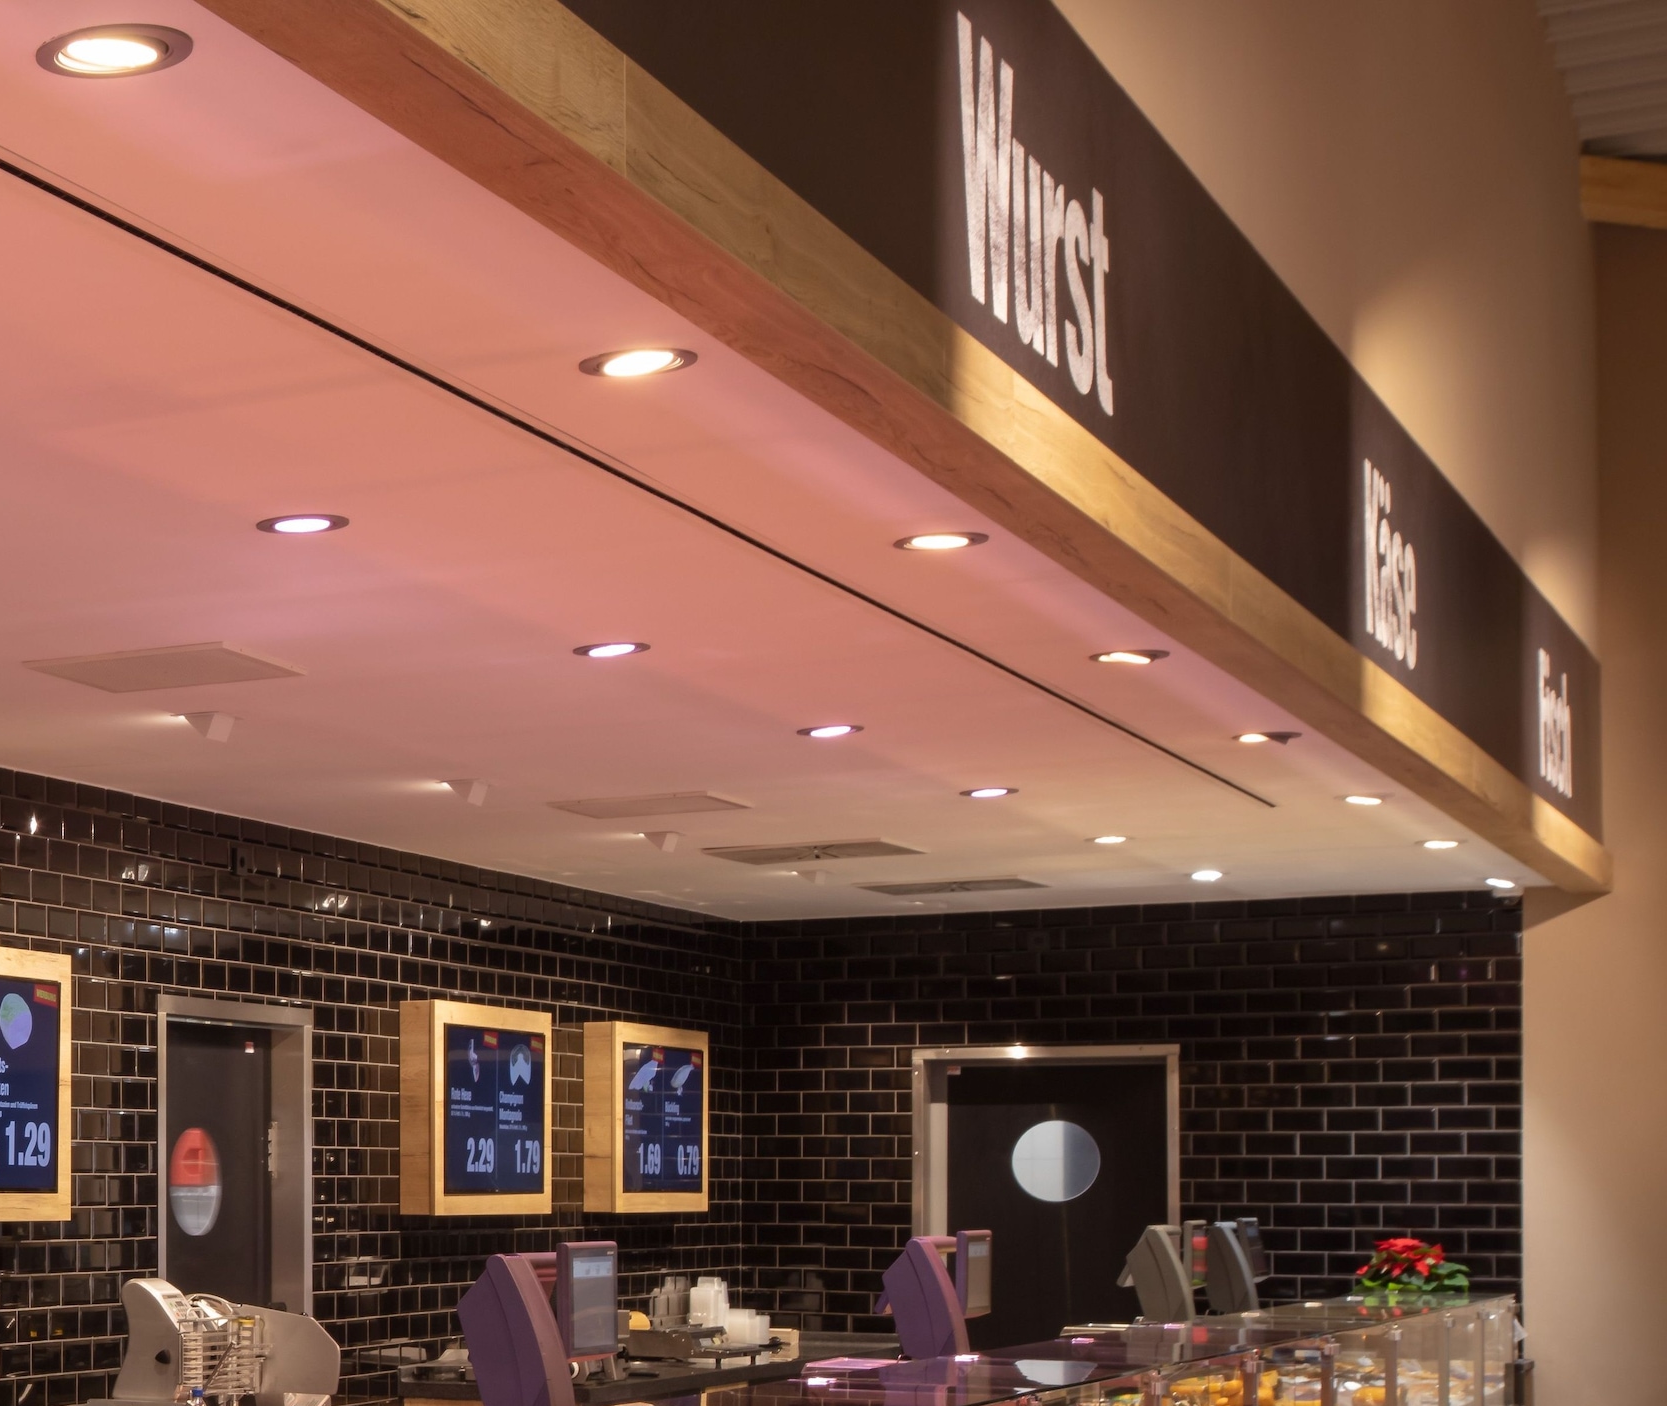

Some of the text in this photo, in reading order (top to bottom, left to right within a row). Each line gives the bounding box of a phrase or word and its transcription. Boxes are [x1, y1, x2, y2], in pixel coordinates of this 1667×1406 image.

[957, 10, 1114, 416] Wurst
[1364, 457, 1418, 670] Käse
[1538, 647, 1573, 799] Fisch
[5, 1120, 51, 1167] 1.29
[467, 1137, 494, 1173] 2.29
[515, 1139, 541, 1174] 1.79
[638, 1143, 661, 1175] 1.69
[677, 1144, 700, 1176] 0.79
